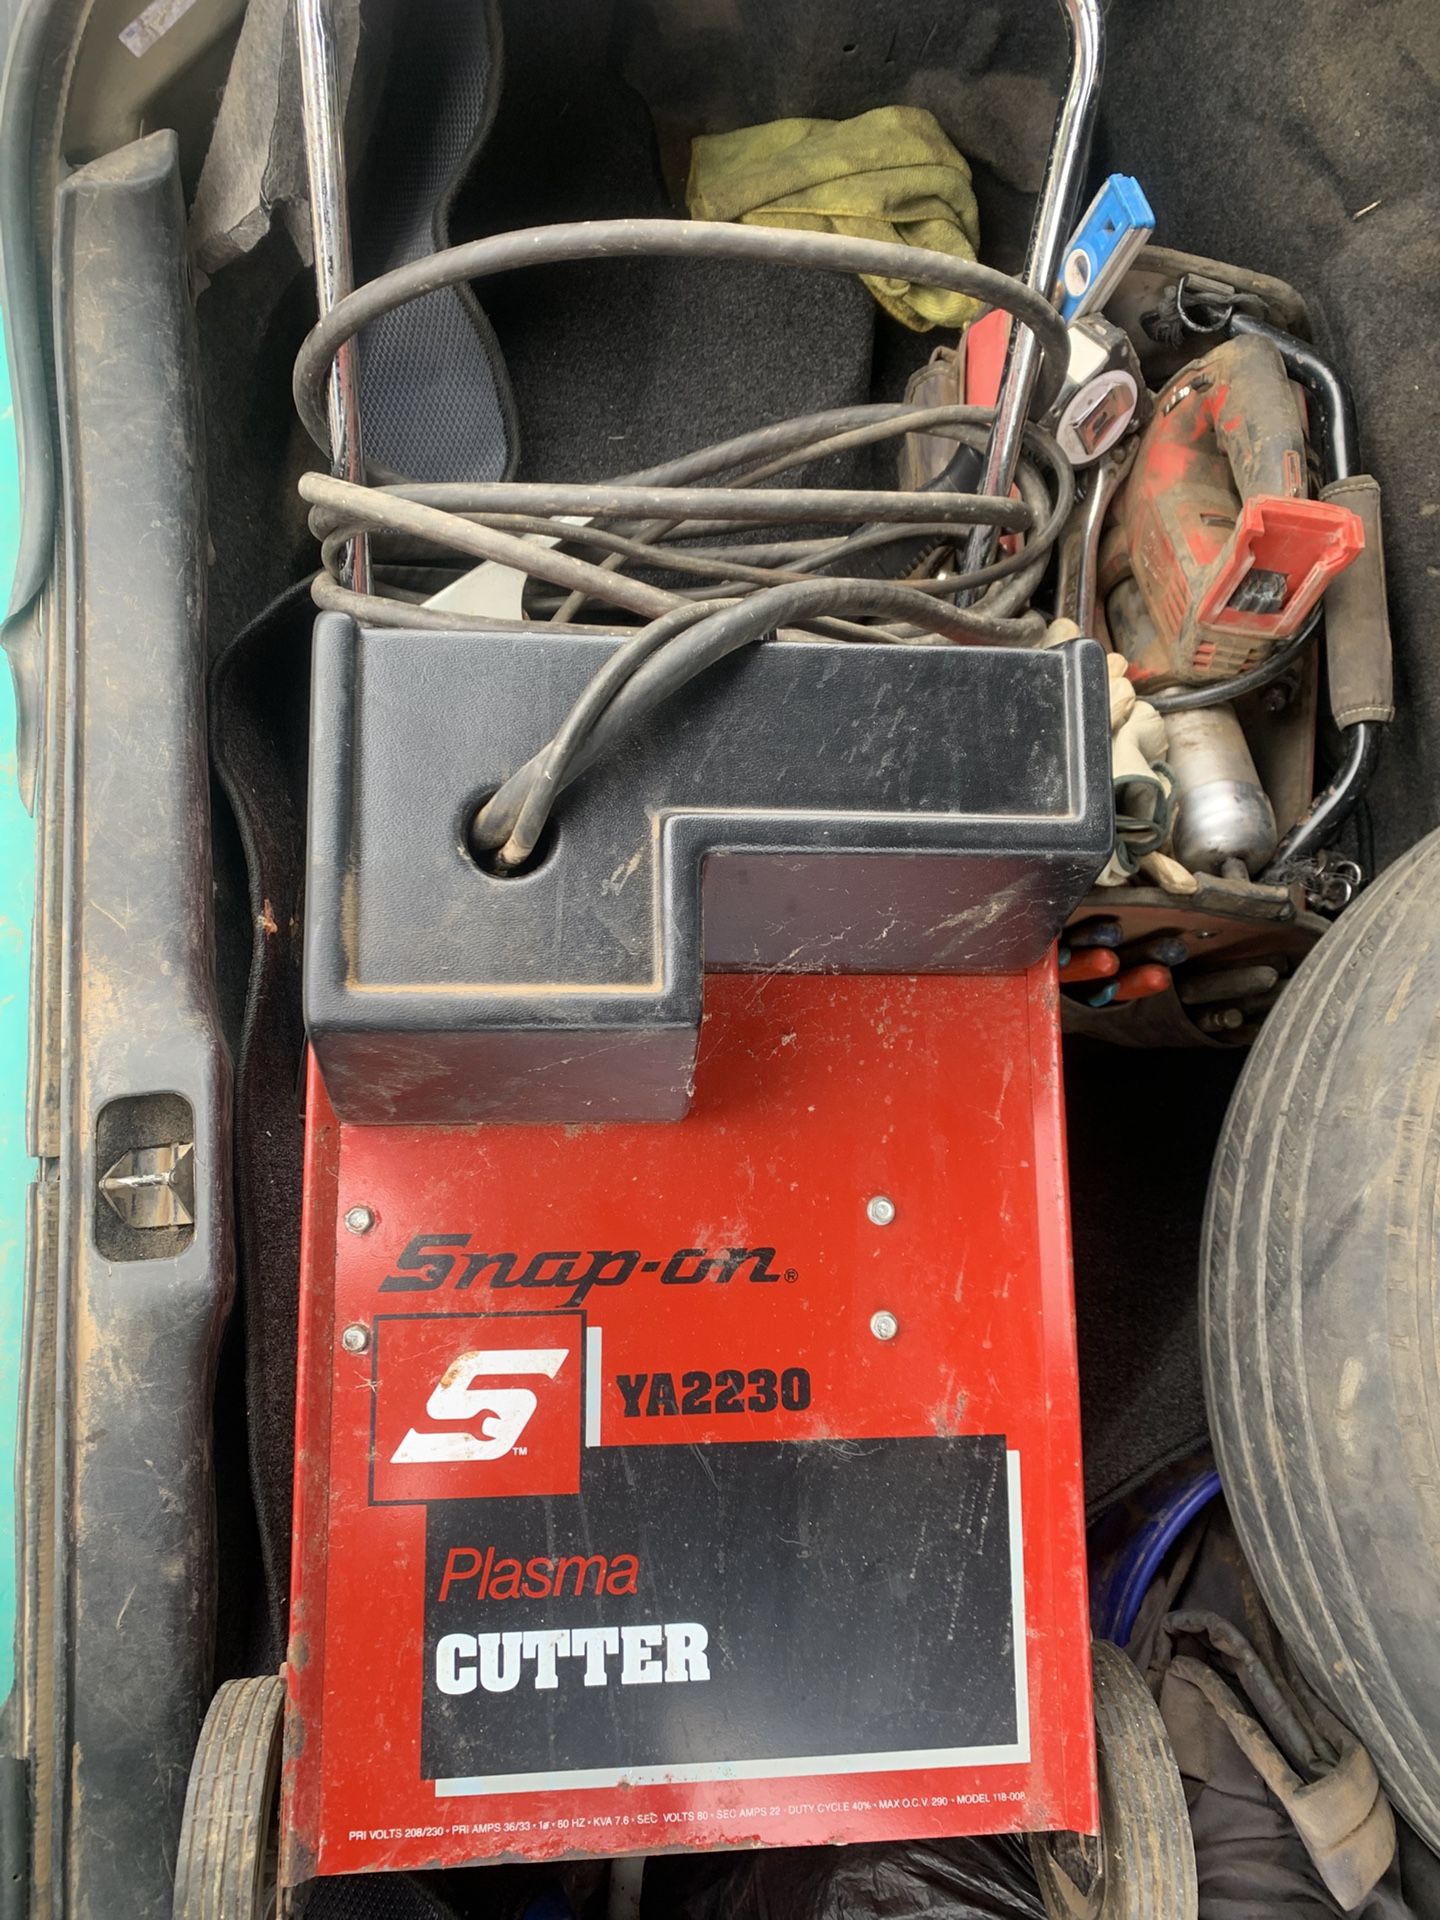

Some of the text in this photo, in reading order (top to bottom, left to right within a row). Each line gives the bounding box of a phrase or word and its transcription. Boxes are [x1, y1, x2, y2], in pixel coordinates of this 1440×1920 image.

[616, 1366, 811, 1418] YA2230
[438, 1546, 640, 1602] Plasma
[435, 1622, 711, 1695] CUTTER
[348, 1830, 367, 1841] PRI
[369, 1828, 403, 1840] VOLTS
[404, 1826, 444, 1838] 208/230
[451, 1824, 469, 1835] PRI
[471, 1823, 501, 1834] AMPS
[503, 1821, 531, 1832] 36/33
[571, 1818, 586, 1828] HZ
[593, 1816, 613, 1826] KVA
[615, 1815, 630, 1825] 7.6
[636, 1812, 659, 1824] SEC
[663, 1811, 695, 1822] VOLTS
[696, 1811, 709, 1820] 80
[715, 1808, 737, 1819] SEC
[738, 1807, 768, 1818] AMPS
[769, 1806, 781, 1816] 22
[788, 1804, 815, 1815] DUTY
[816, 1802, 850, 1812] CYCLE
[851, 1801, 872, 1811] 40%
[878, 1799, 900, 1809] MAX
[931, 1796, 948, 1806] 290
[956, 1793, 991, 1805] MODEL
